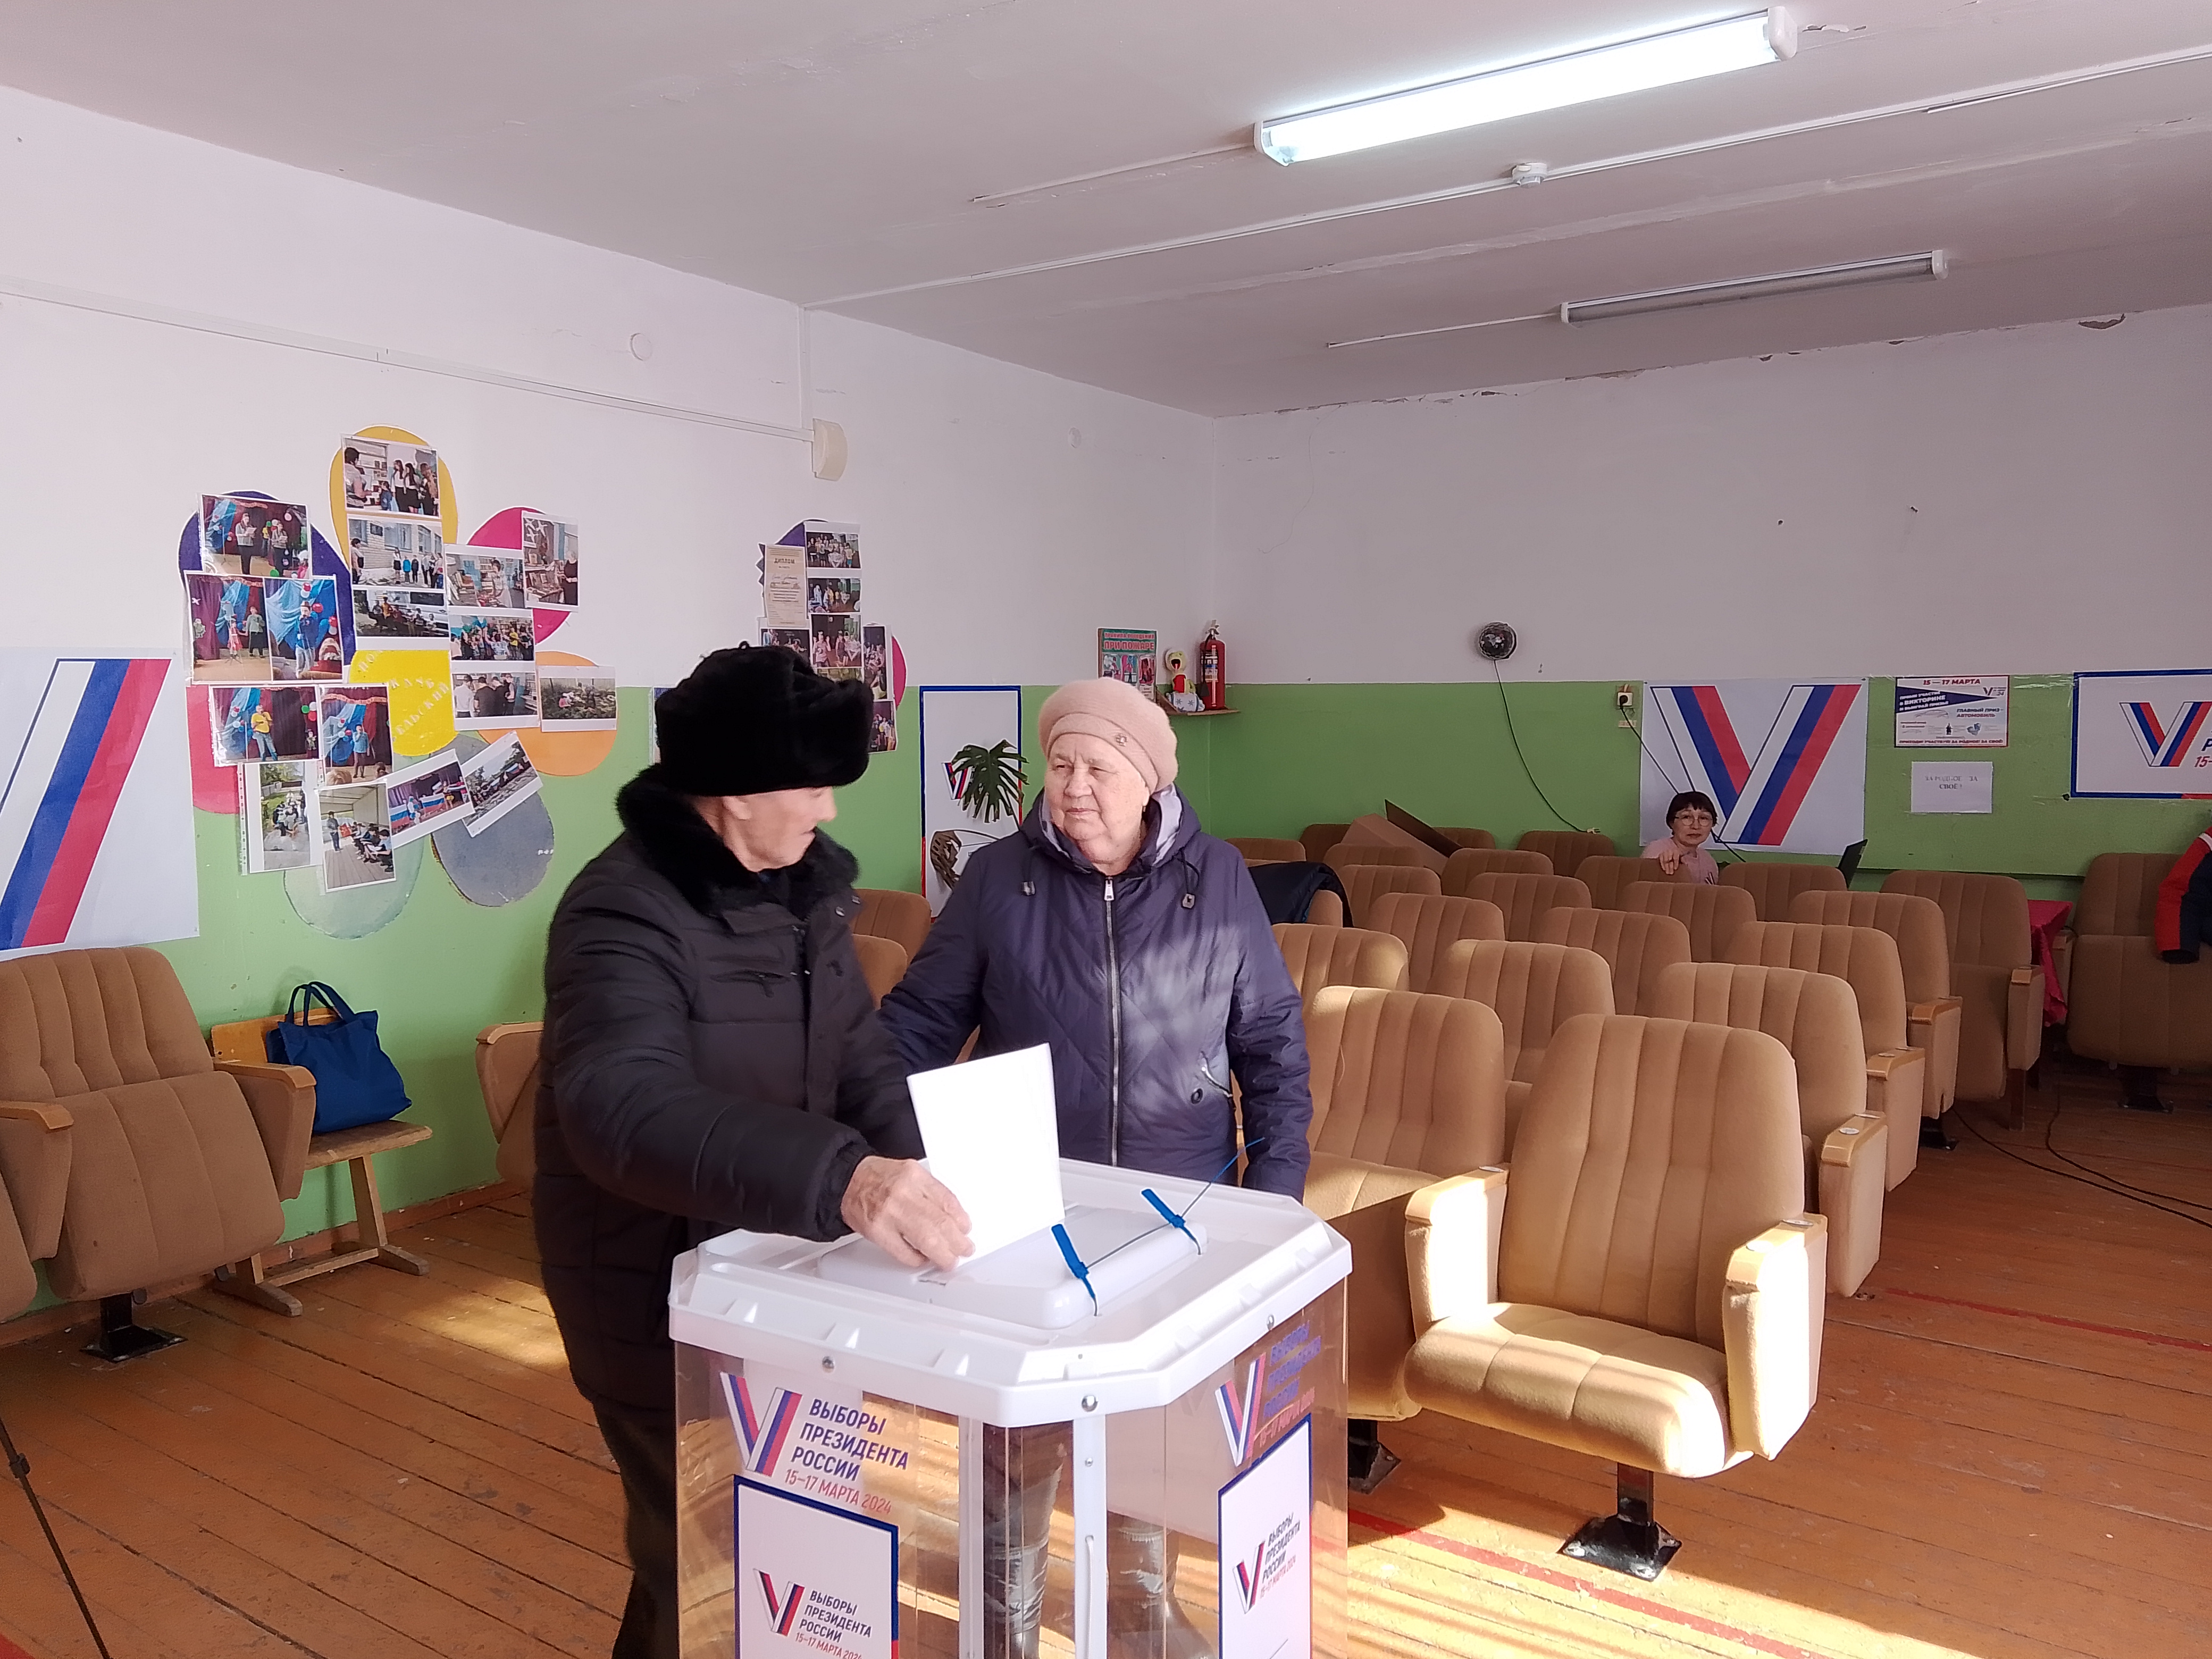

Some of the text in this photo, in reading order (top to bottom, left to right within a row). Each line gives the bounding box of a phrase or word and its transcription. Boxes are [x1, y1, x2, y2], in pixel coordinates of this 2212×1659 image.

[1122, 641, 1154, 650] ПОЖАРЕ
[1904, 695, 1946, 705] ВИКТОРИНЕ
[809, 1398, 886, 1435] ВЫБОРЫ
[800, 1422, 909, 1470] ПРЕЗИДЕНТА
[791, 1446, 860, 1481] РОССИИ
[818, 1480, 860, 1505] МАРТА
[861, 1493, 892, 1514] 2024
[809, 1590, 857, 1616] ВЫБОРЫ
[799, 1619, 842, 1643] РОССИИ
[804, 1604, 872, 1638] ПРЕЗИДЕНТА
[816, 1640, 842, 1657] МАРТА
